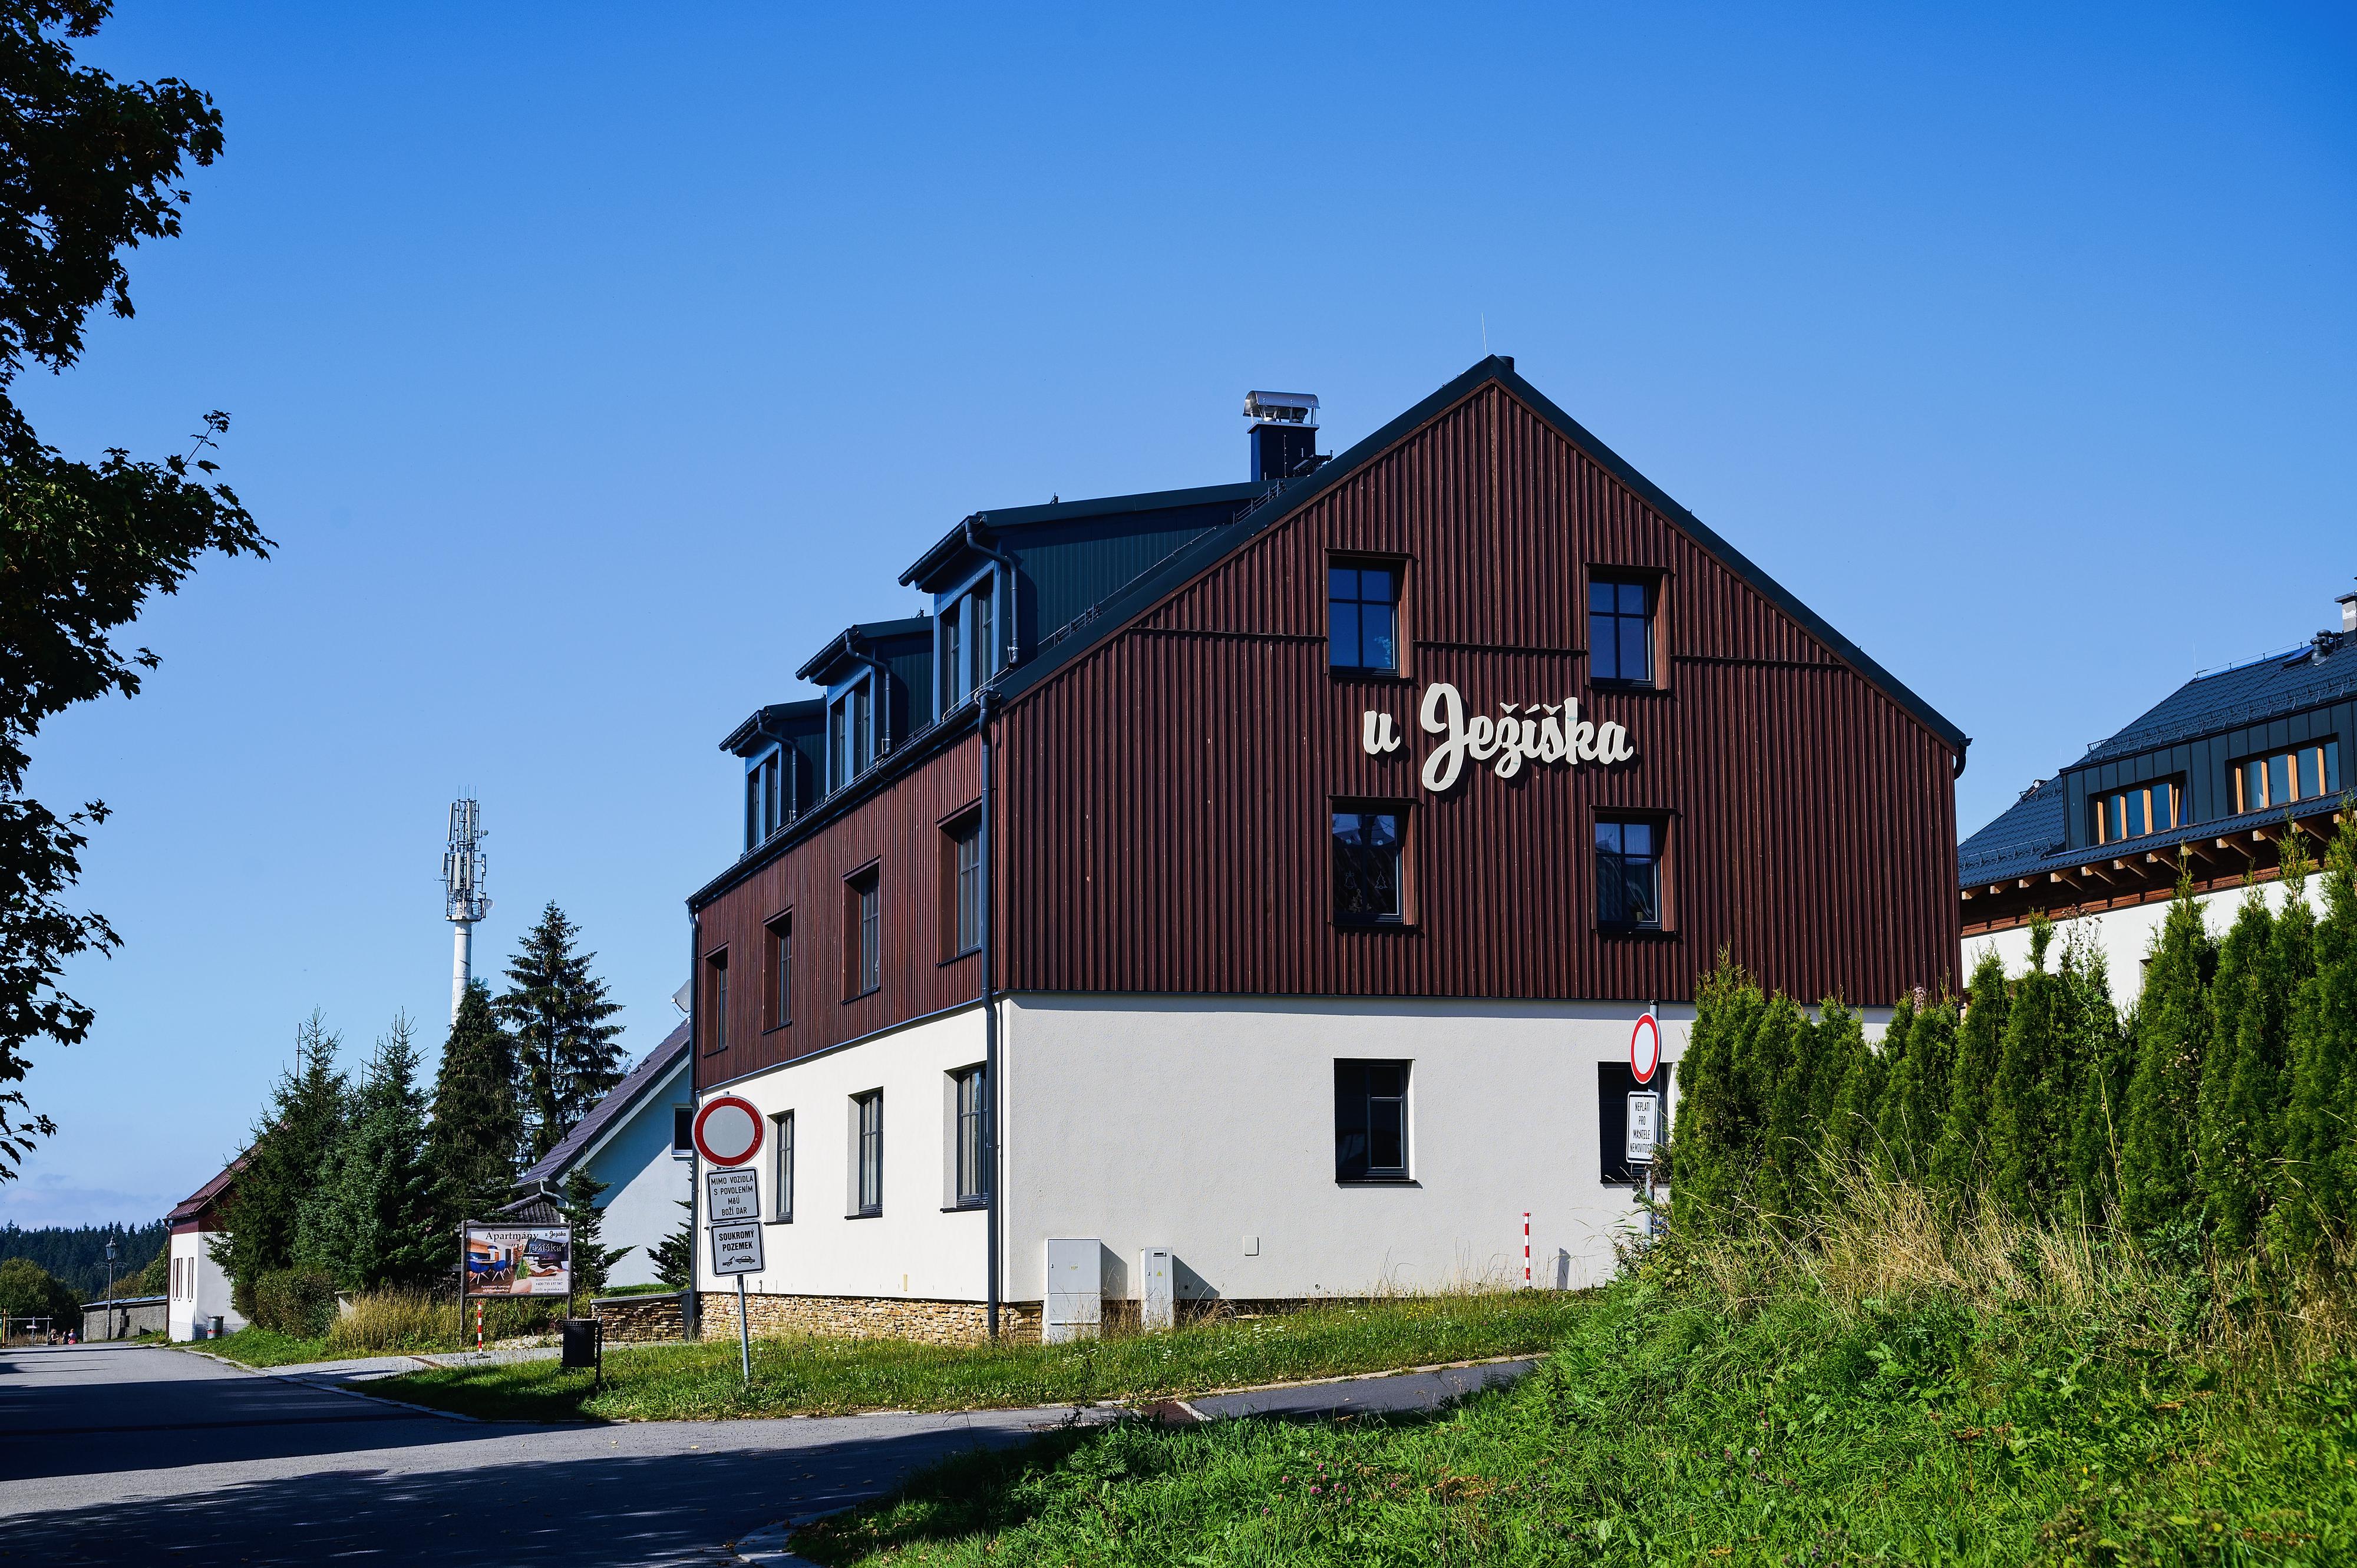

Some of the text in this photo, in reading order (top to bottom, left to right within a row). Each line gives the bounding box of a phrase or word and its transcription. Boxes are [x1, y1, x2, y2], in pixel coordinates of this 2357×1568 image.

[1363, 682, 1634, 791] u Ježíška
[1635, 1099, 1650, 1111] NEPLATÍ
[711, 1175, 754, 1186] MIMO VOZIDLA
[721, 1184, 753, 1195] POVOLENÍM
[728, 1196, 740, 1205] MěÚ
[721, 1206, 734, 1216] BOŽÍ
[486, 1232, 539, 1242] Apartmány
[719, 1229, 754, 1241] SOUKROMÝ
[722, 1241, 753, 1252] POZEMEK
